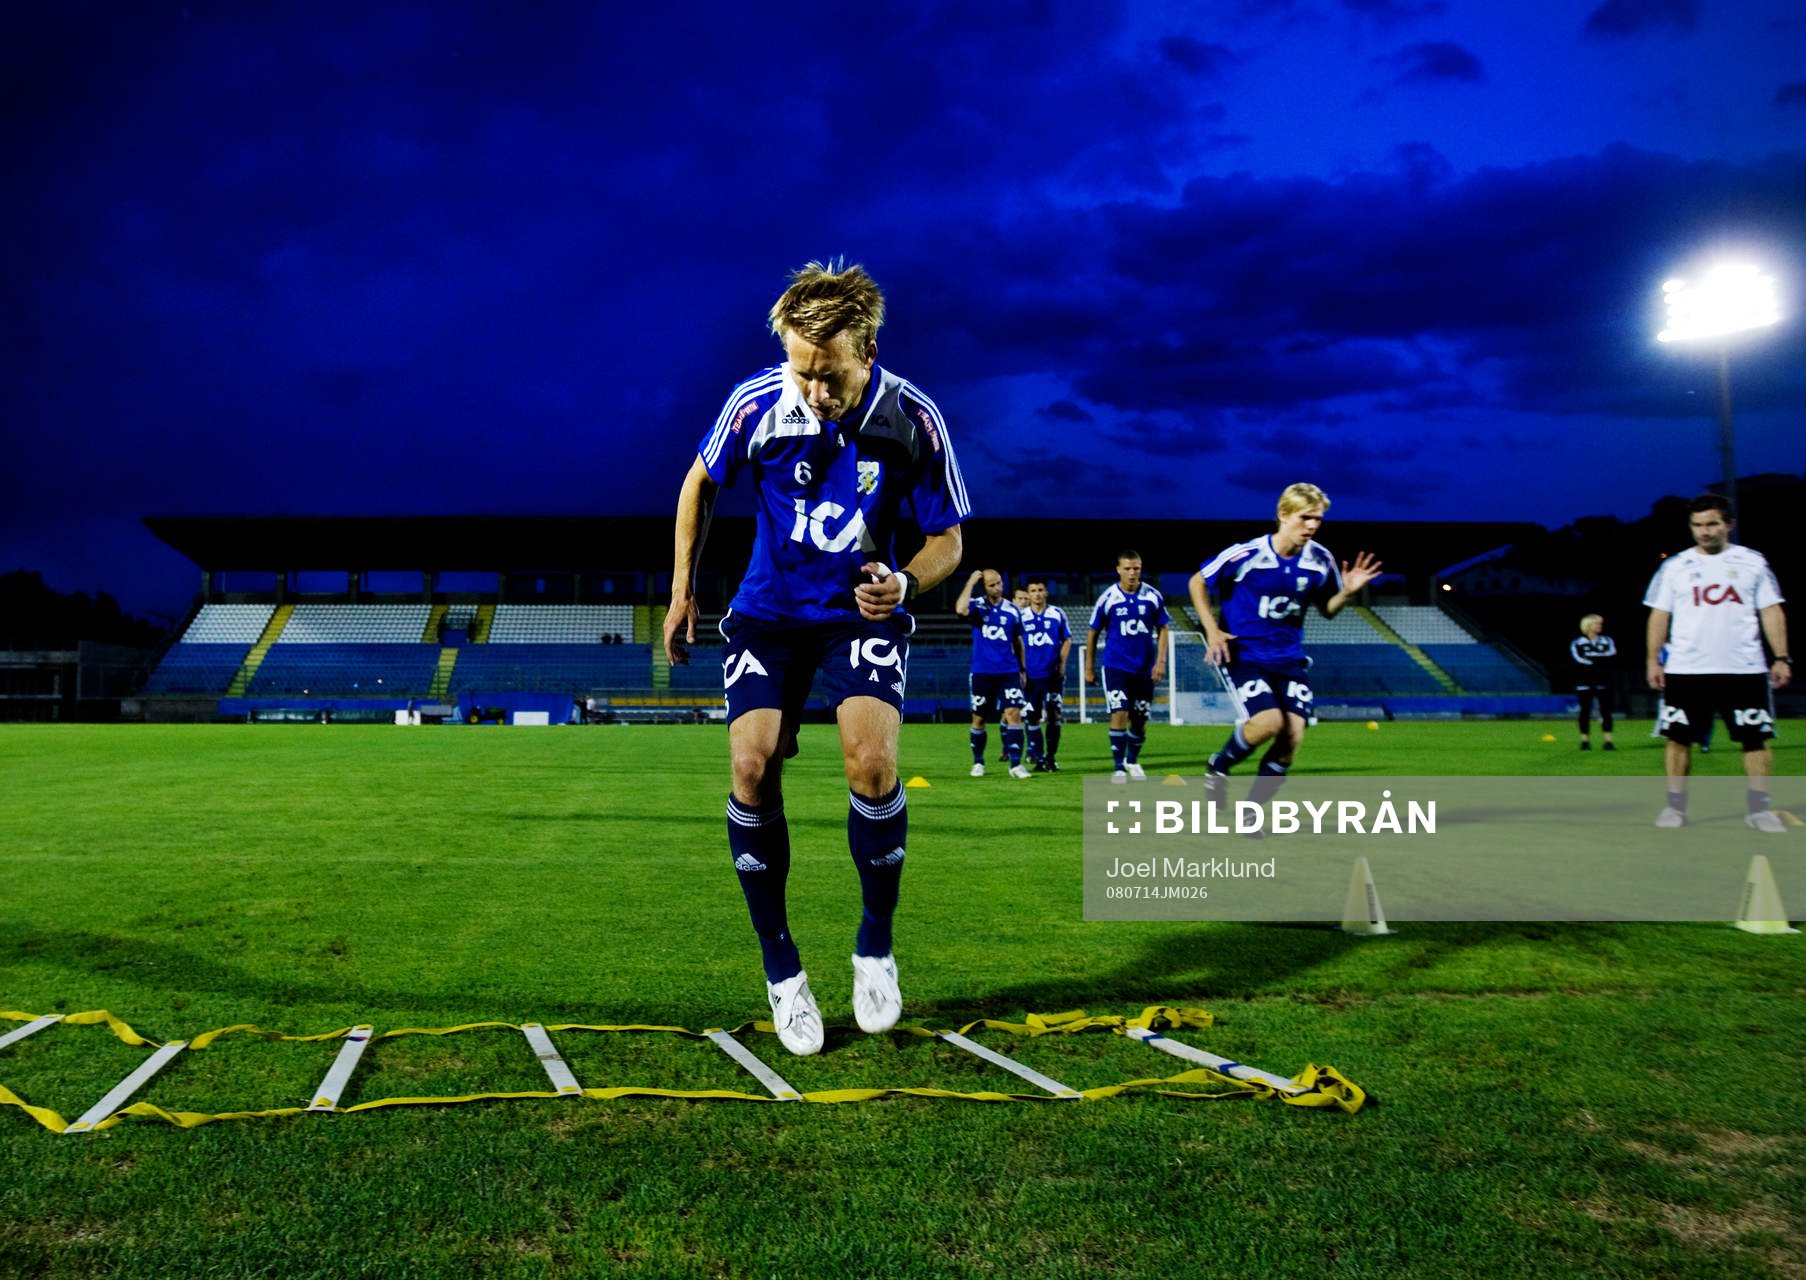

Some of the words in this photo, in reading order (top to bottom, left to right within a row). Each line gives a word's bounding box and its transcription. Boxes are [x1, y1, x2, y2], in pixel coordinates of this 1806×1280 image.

[794, 461, 812, 485] 6
[790, 498, 877, 553] ICA
[1693, 584, 1744, 607] ICA
[982, 625, 1008, 640] ICA
[1120, 619, 1149, 636] ICA
[1028, 632, 1054, 646] ICA
[722, 649, 769, 689] CA
[869, 669, 880, 682] A
[1734, 708, 1773, 726] ICA
